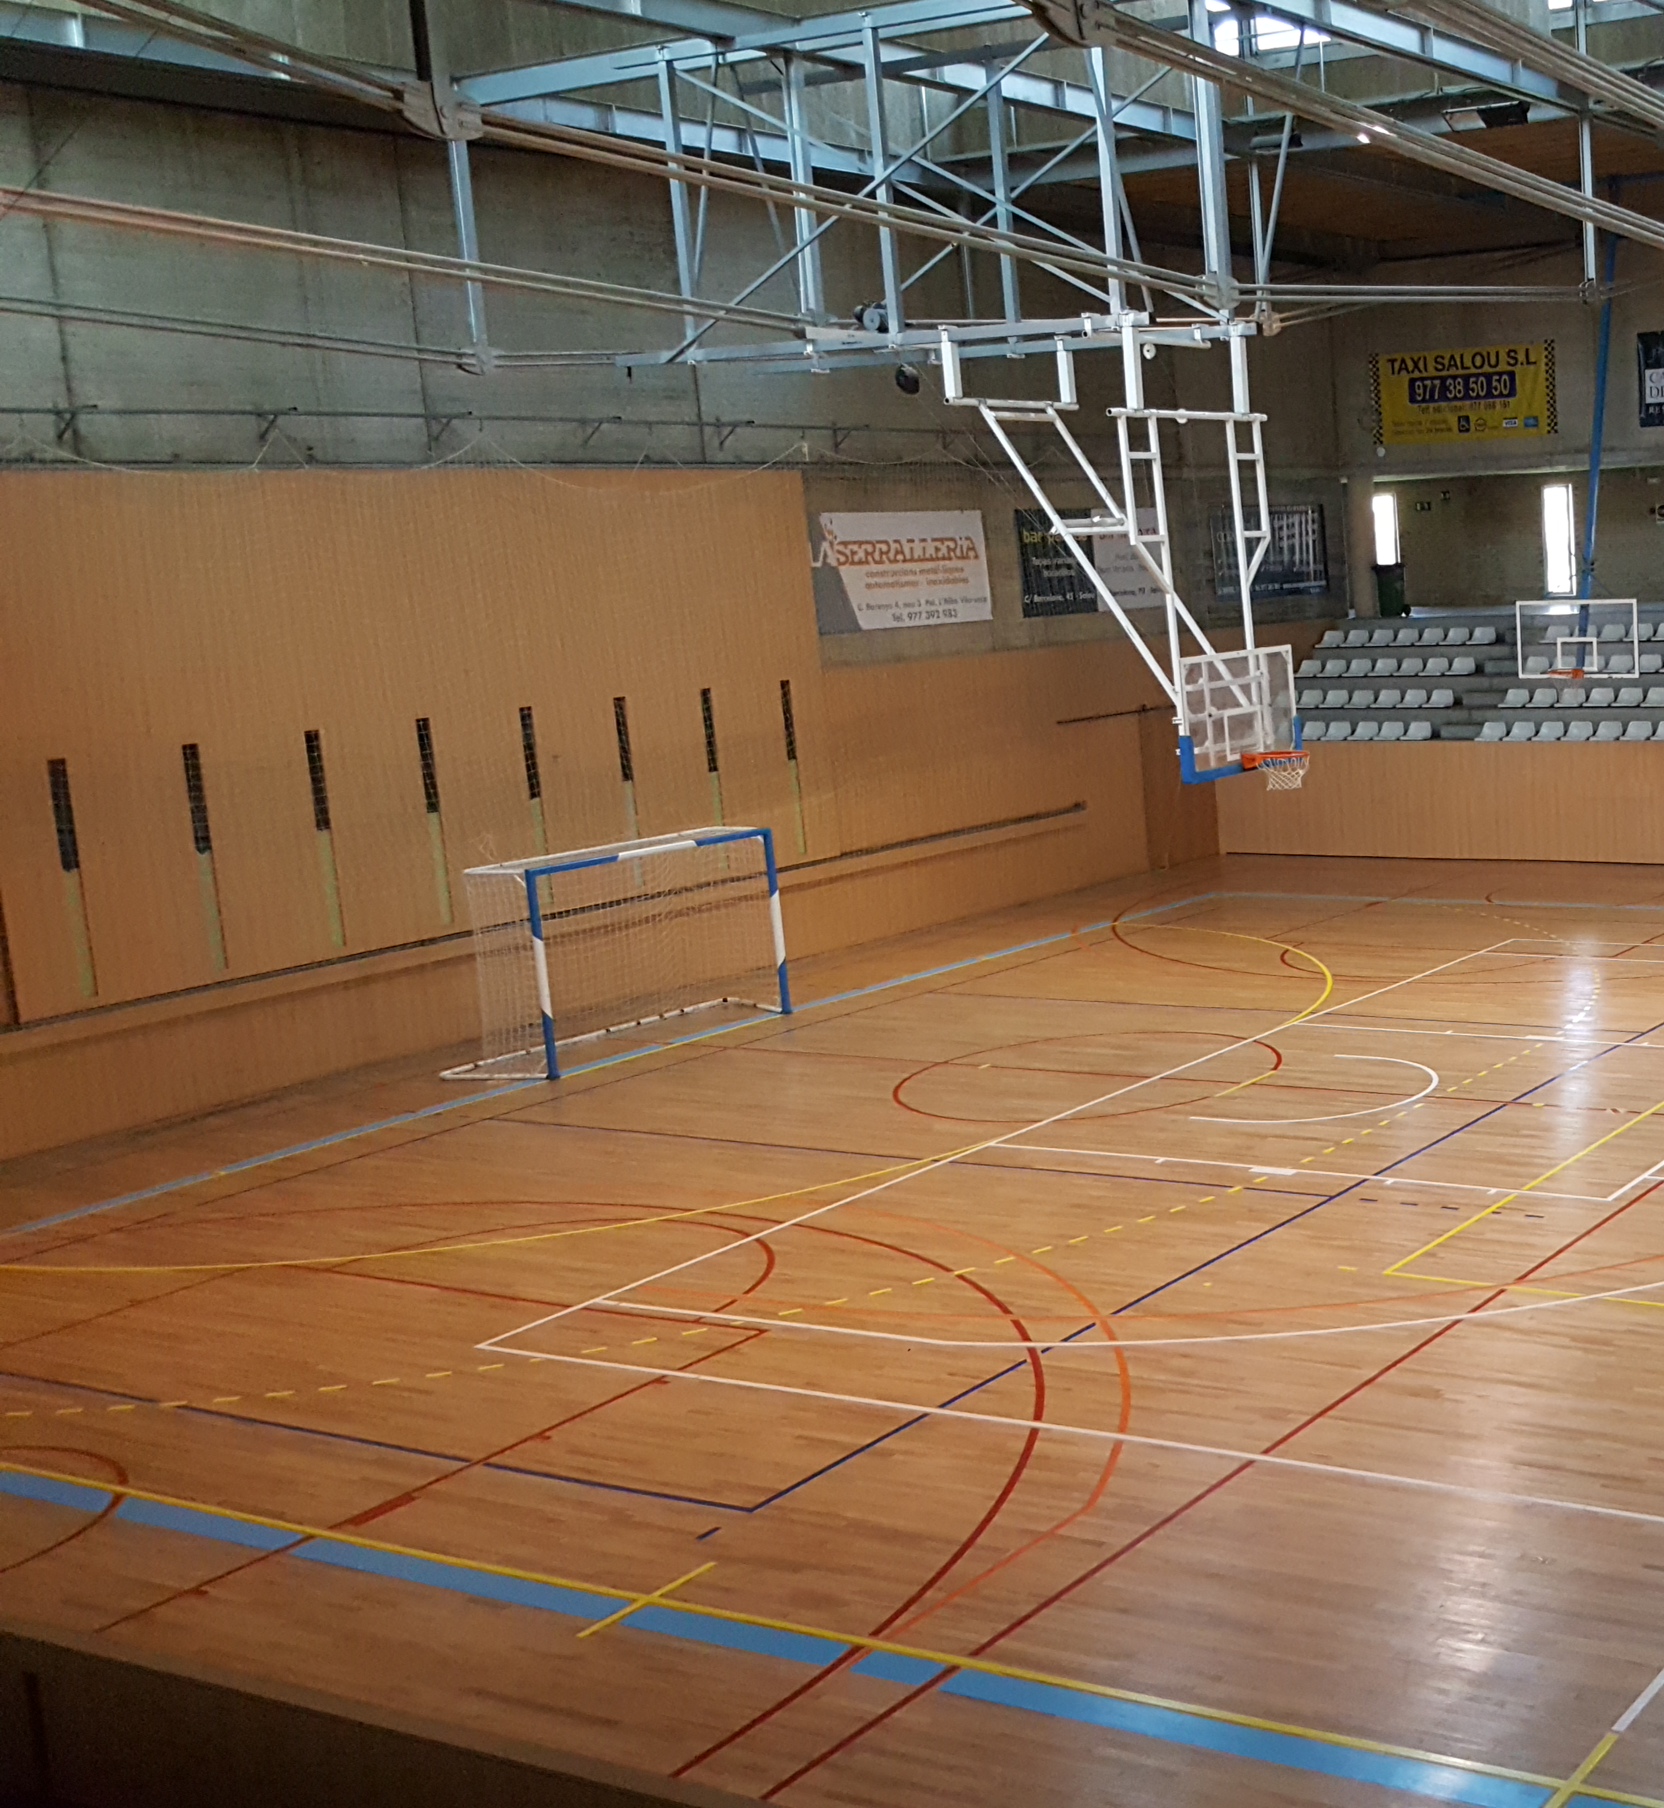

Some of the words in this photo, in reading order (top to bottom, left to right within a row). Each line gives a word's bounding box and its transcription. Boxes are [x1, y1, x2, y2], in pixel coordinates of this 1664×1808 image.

[1386, 357, 1428, 376] TAXI
[1434, 350, 1500, 372] SALOU
[1506, 348, 1537, 367] S.L
[1414, 379, 1441, 401] 977
[1446, 377, 1465, 399] 38
[1469, 376, 1487, 398] 50
[1491, 374, 1510, 396] 50
[1023, 529, 1042, 543] bar
[907, 611, 922, 622] 977
